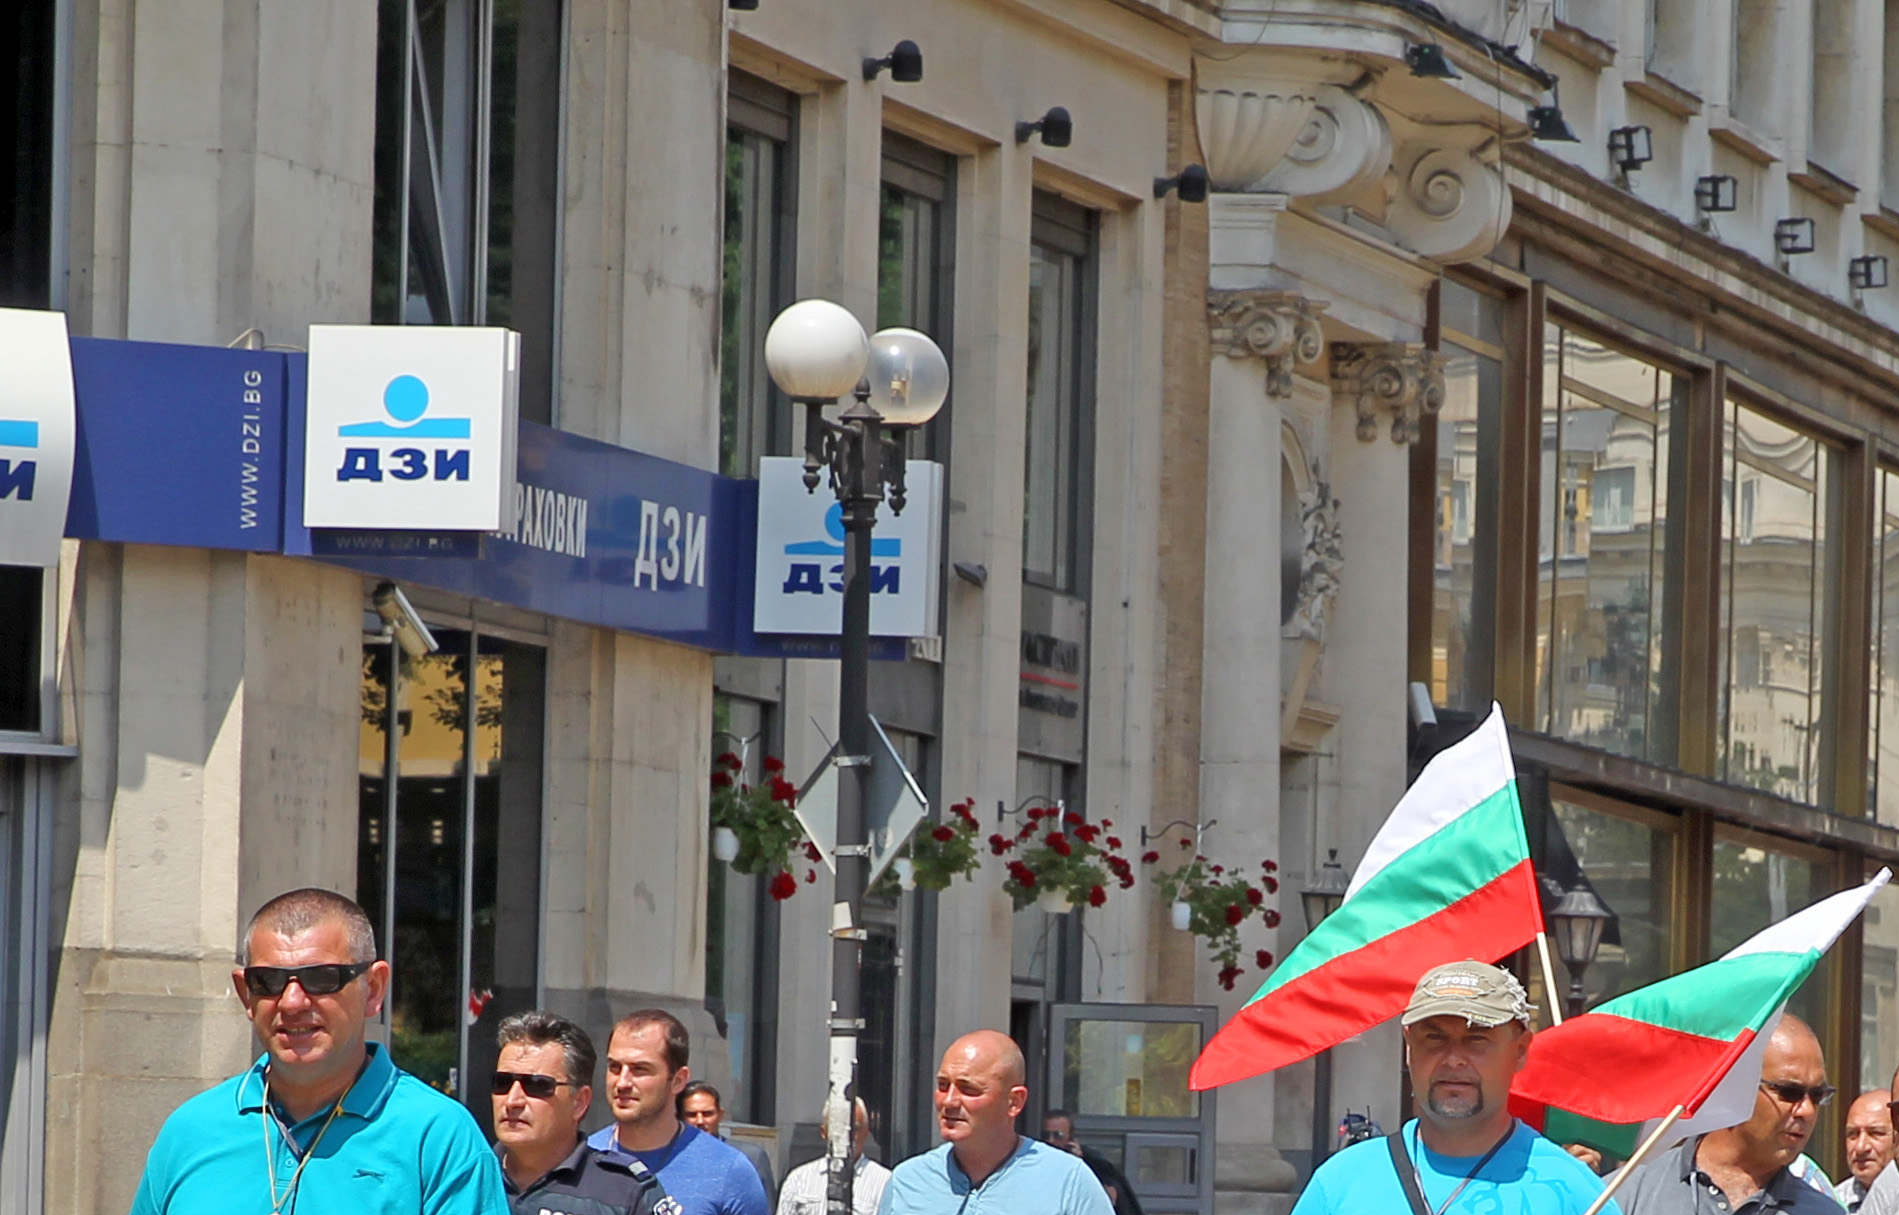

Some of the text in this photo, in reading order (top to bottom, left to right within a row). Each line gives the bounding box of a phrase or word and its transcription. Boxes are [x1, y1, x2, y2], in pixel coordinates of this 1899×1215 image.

[240, 370, 262, 529] WWW.DZI.BG
[336, 448, 470, 482] ДЗИ
[490, 483, 707, 591] РАХОВКИ ДЗИ
